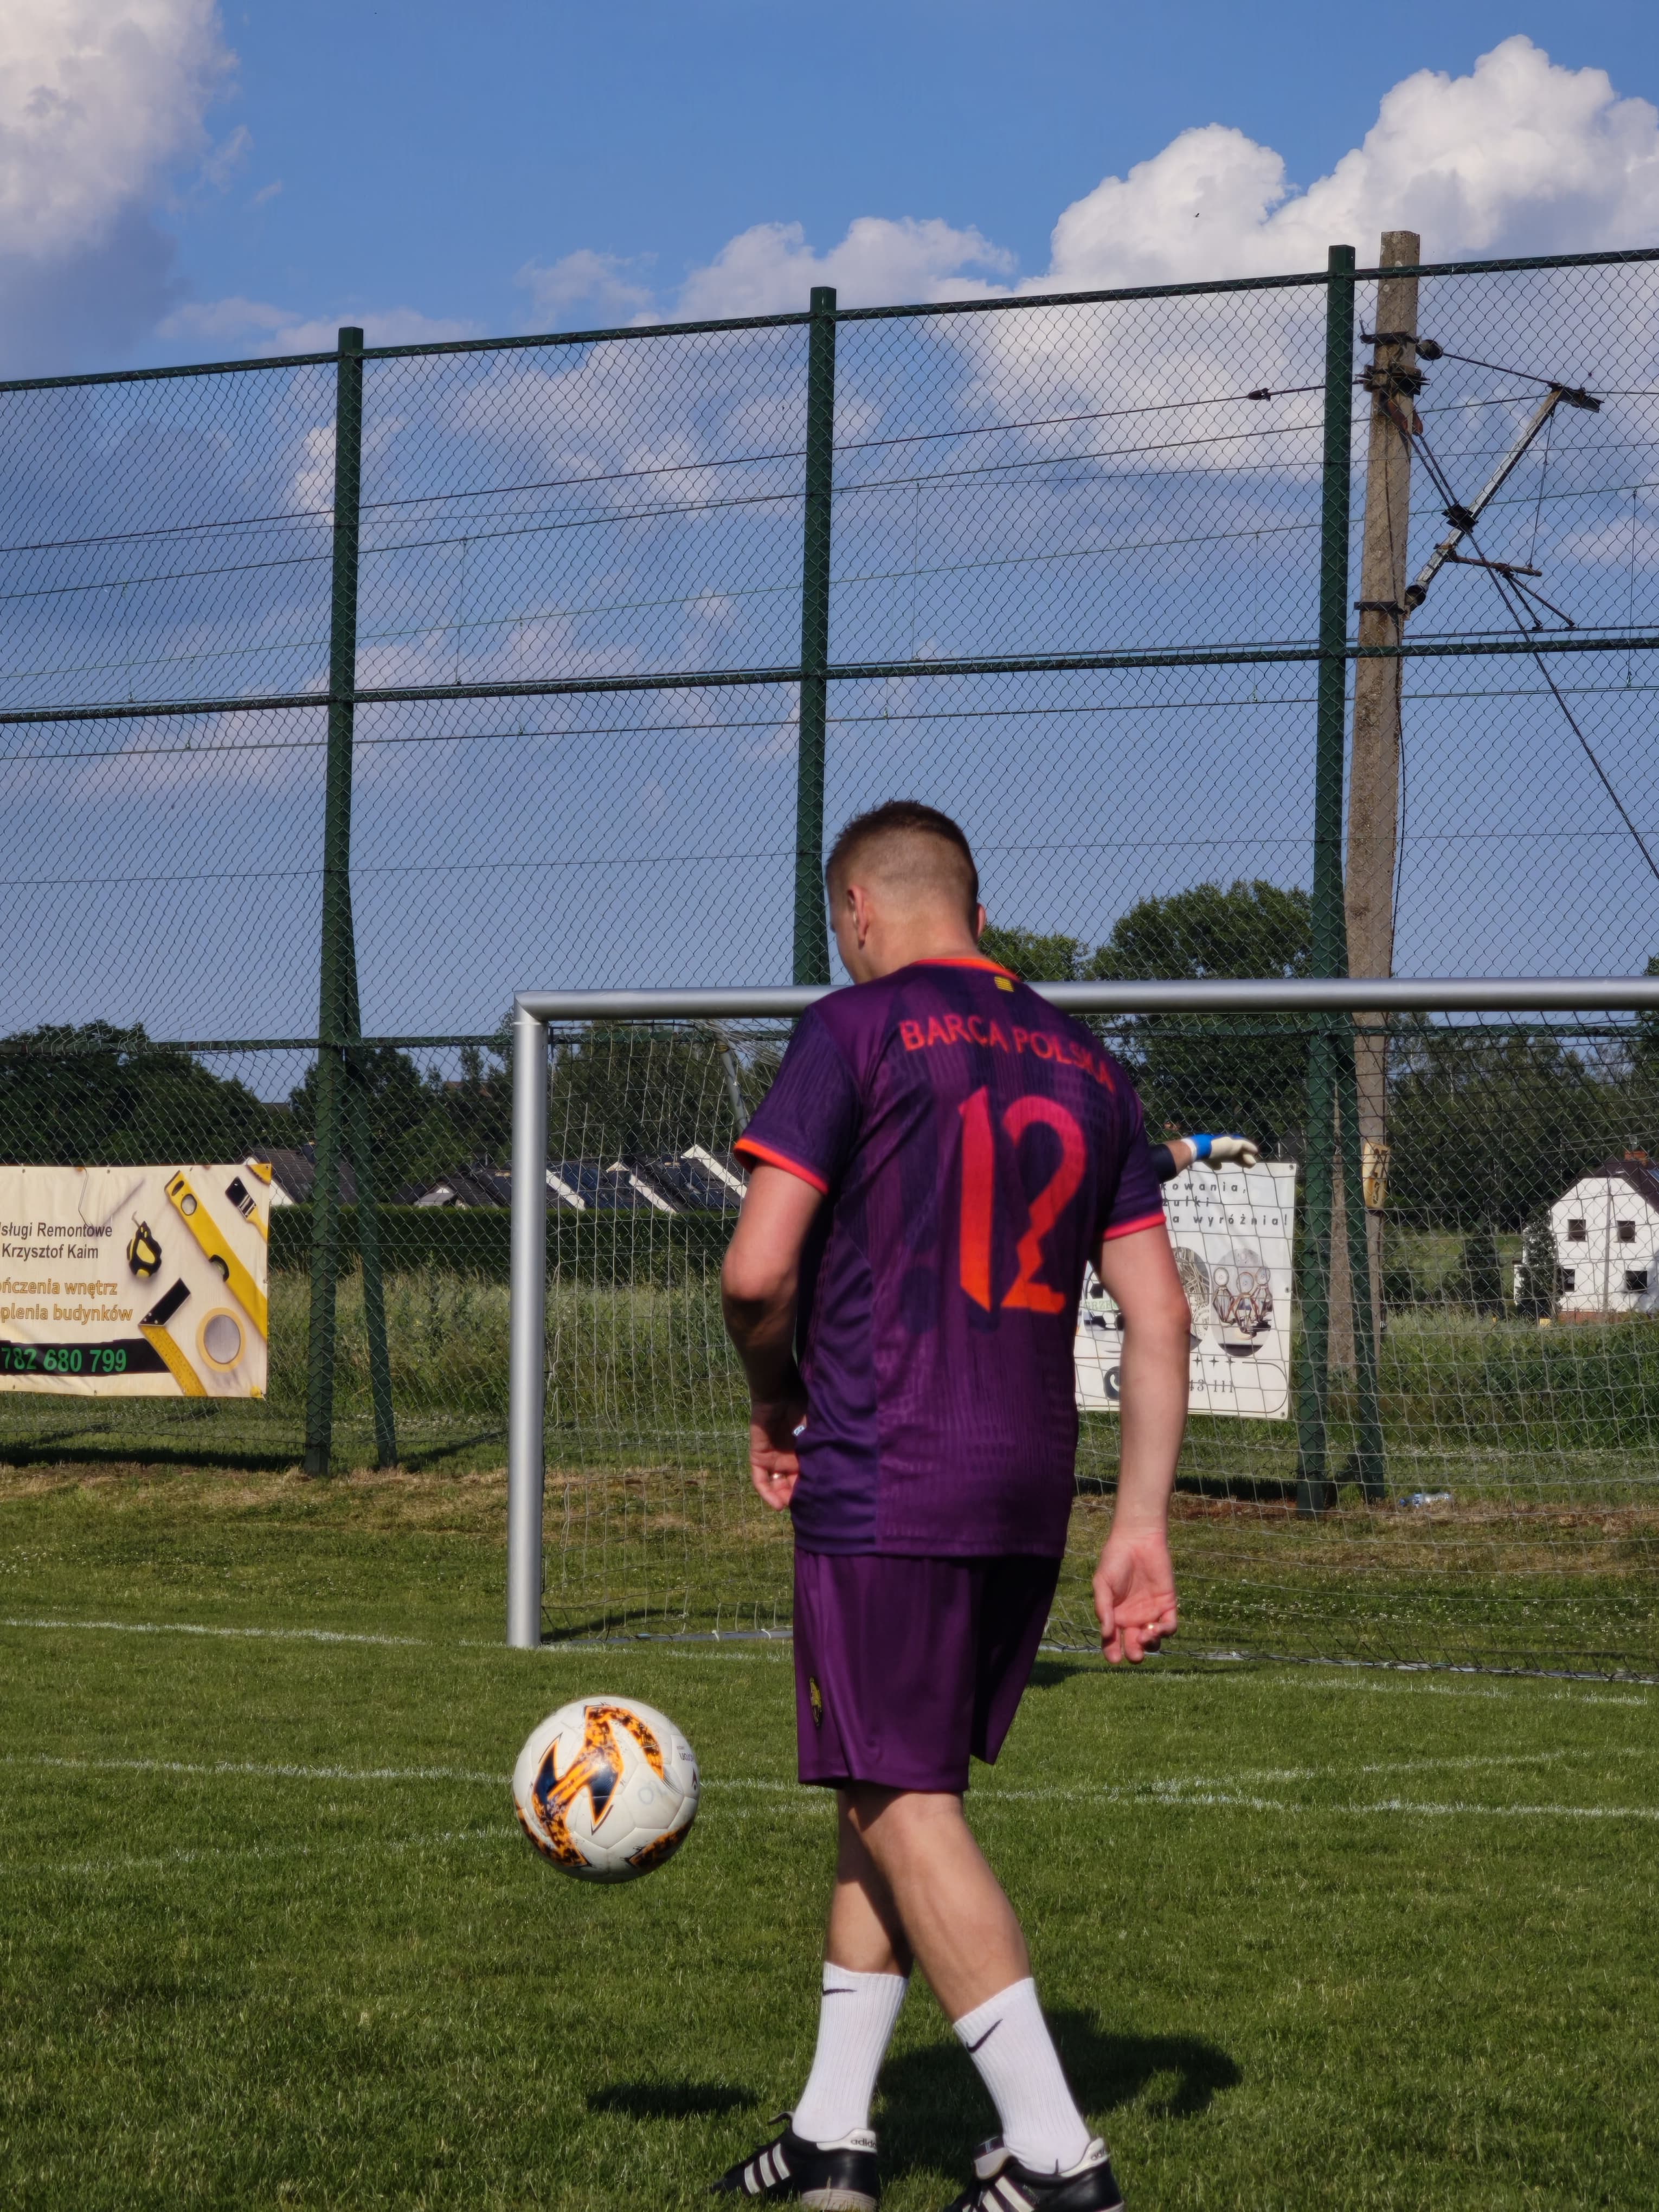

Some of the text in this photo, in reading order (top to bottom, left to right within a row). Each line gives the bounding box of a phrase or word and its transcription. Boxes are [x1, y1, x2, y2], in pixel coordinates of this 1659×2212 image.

[958, 1086, 1087, 1313] 12
[1162, 1196, 1209, 1207] zulki
[1193, 1214, 1287, 1227] wyróżnia!
[0, 1221, 112, 1240] sługi Remontowe
[2, 1243, 98, 1262] Krzysztof Kaim
[0, 1277, 118, 1299] ńczenia wnętrz
[0, 1303, 133, 1325] plenia budynków
[2, 1347, 126, 1372] 782 680 799
[1189, 1379, 1204, 1392] 43
